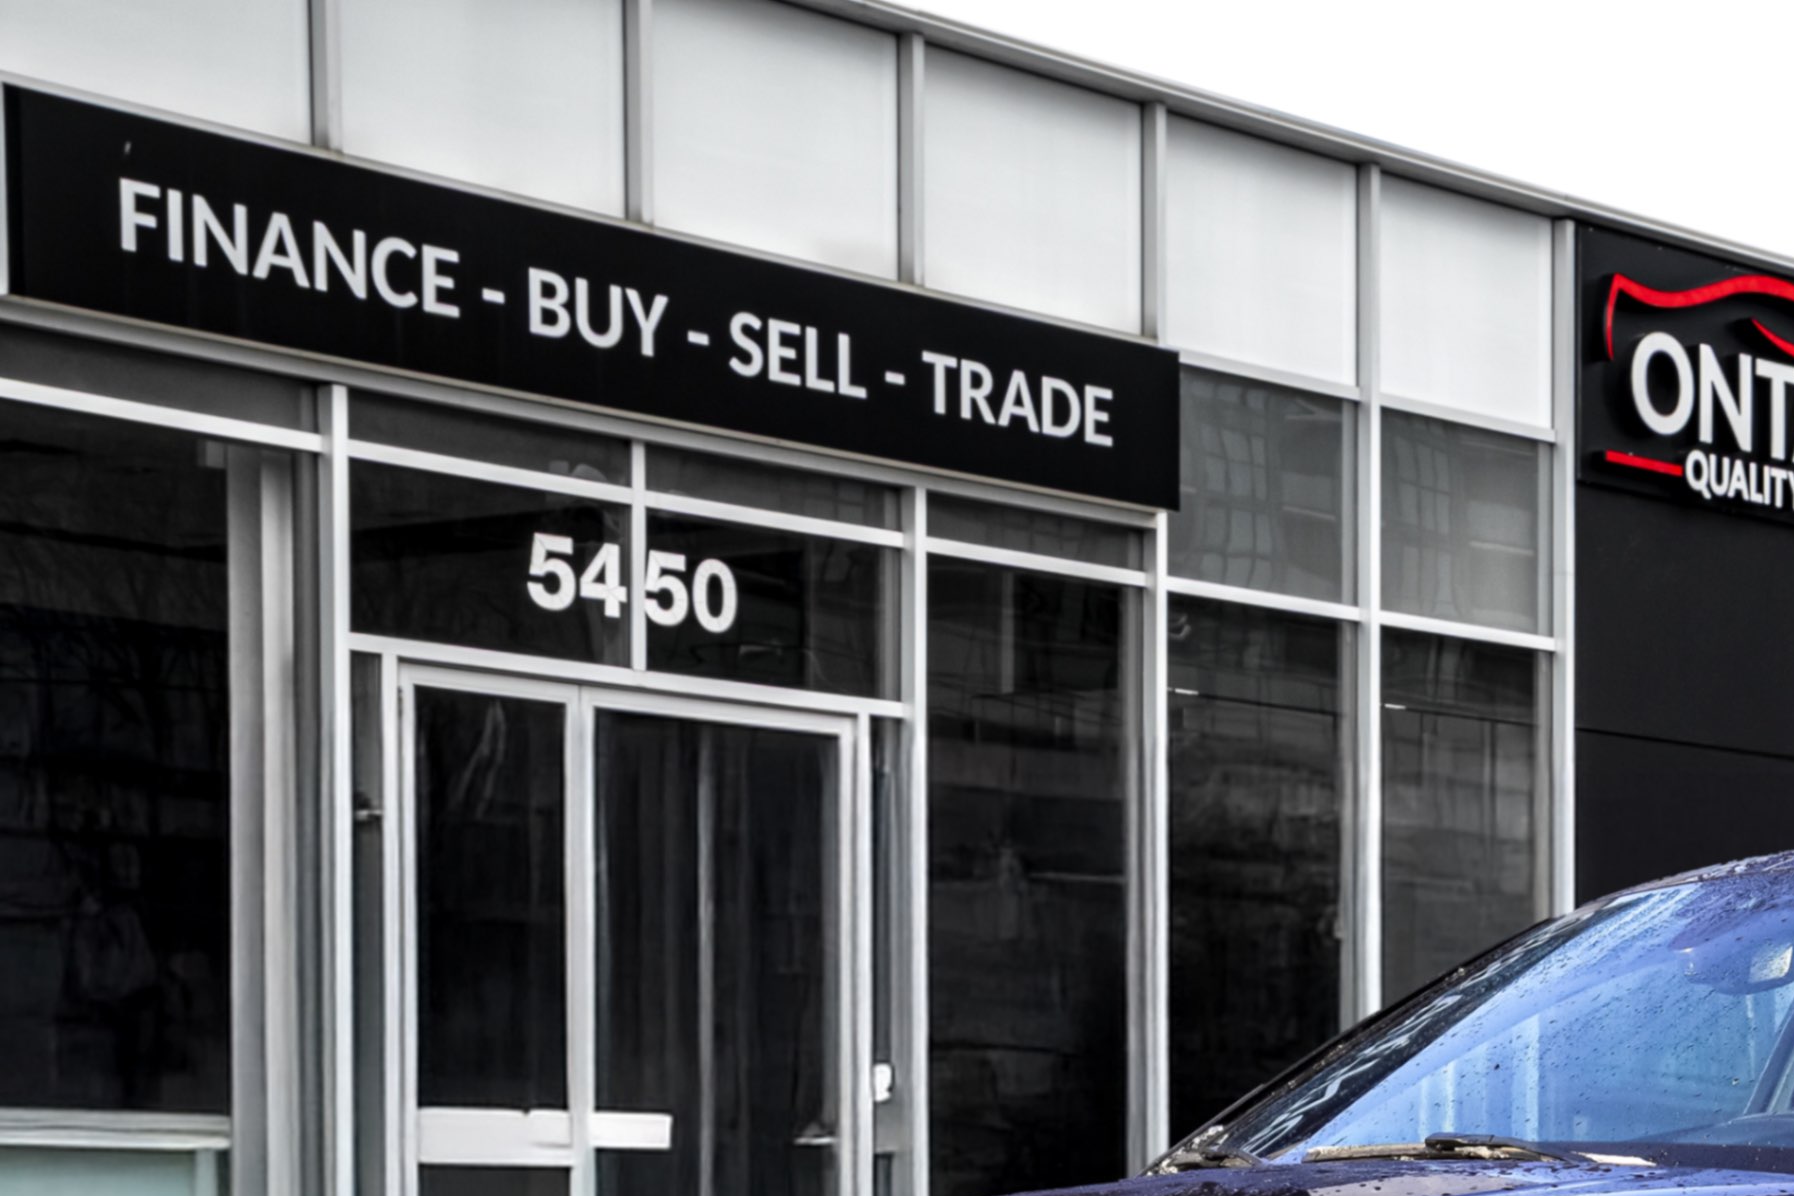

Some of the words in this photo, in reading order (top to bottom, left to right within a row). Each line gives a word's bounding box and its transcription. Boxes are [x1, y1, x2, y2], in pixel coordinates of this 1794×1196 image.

[119, 178, 460, 318] FINANCE
[527, 267, 668, 356] BUY
[729, 312, 867, 399] SELL
[922, 351, 1114, 446] TRADE
[527, 533, 737, 633] 5450
